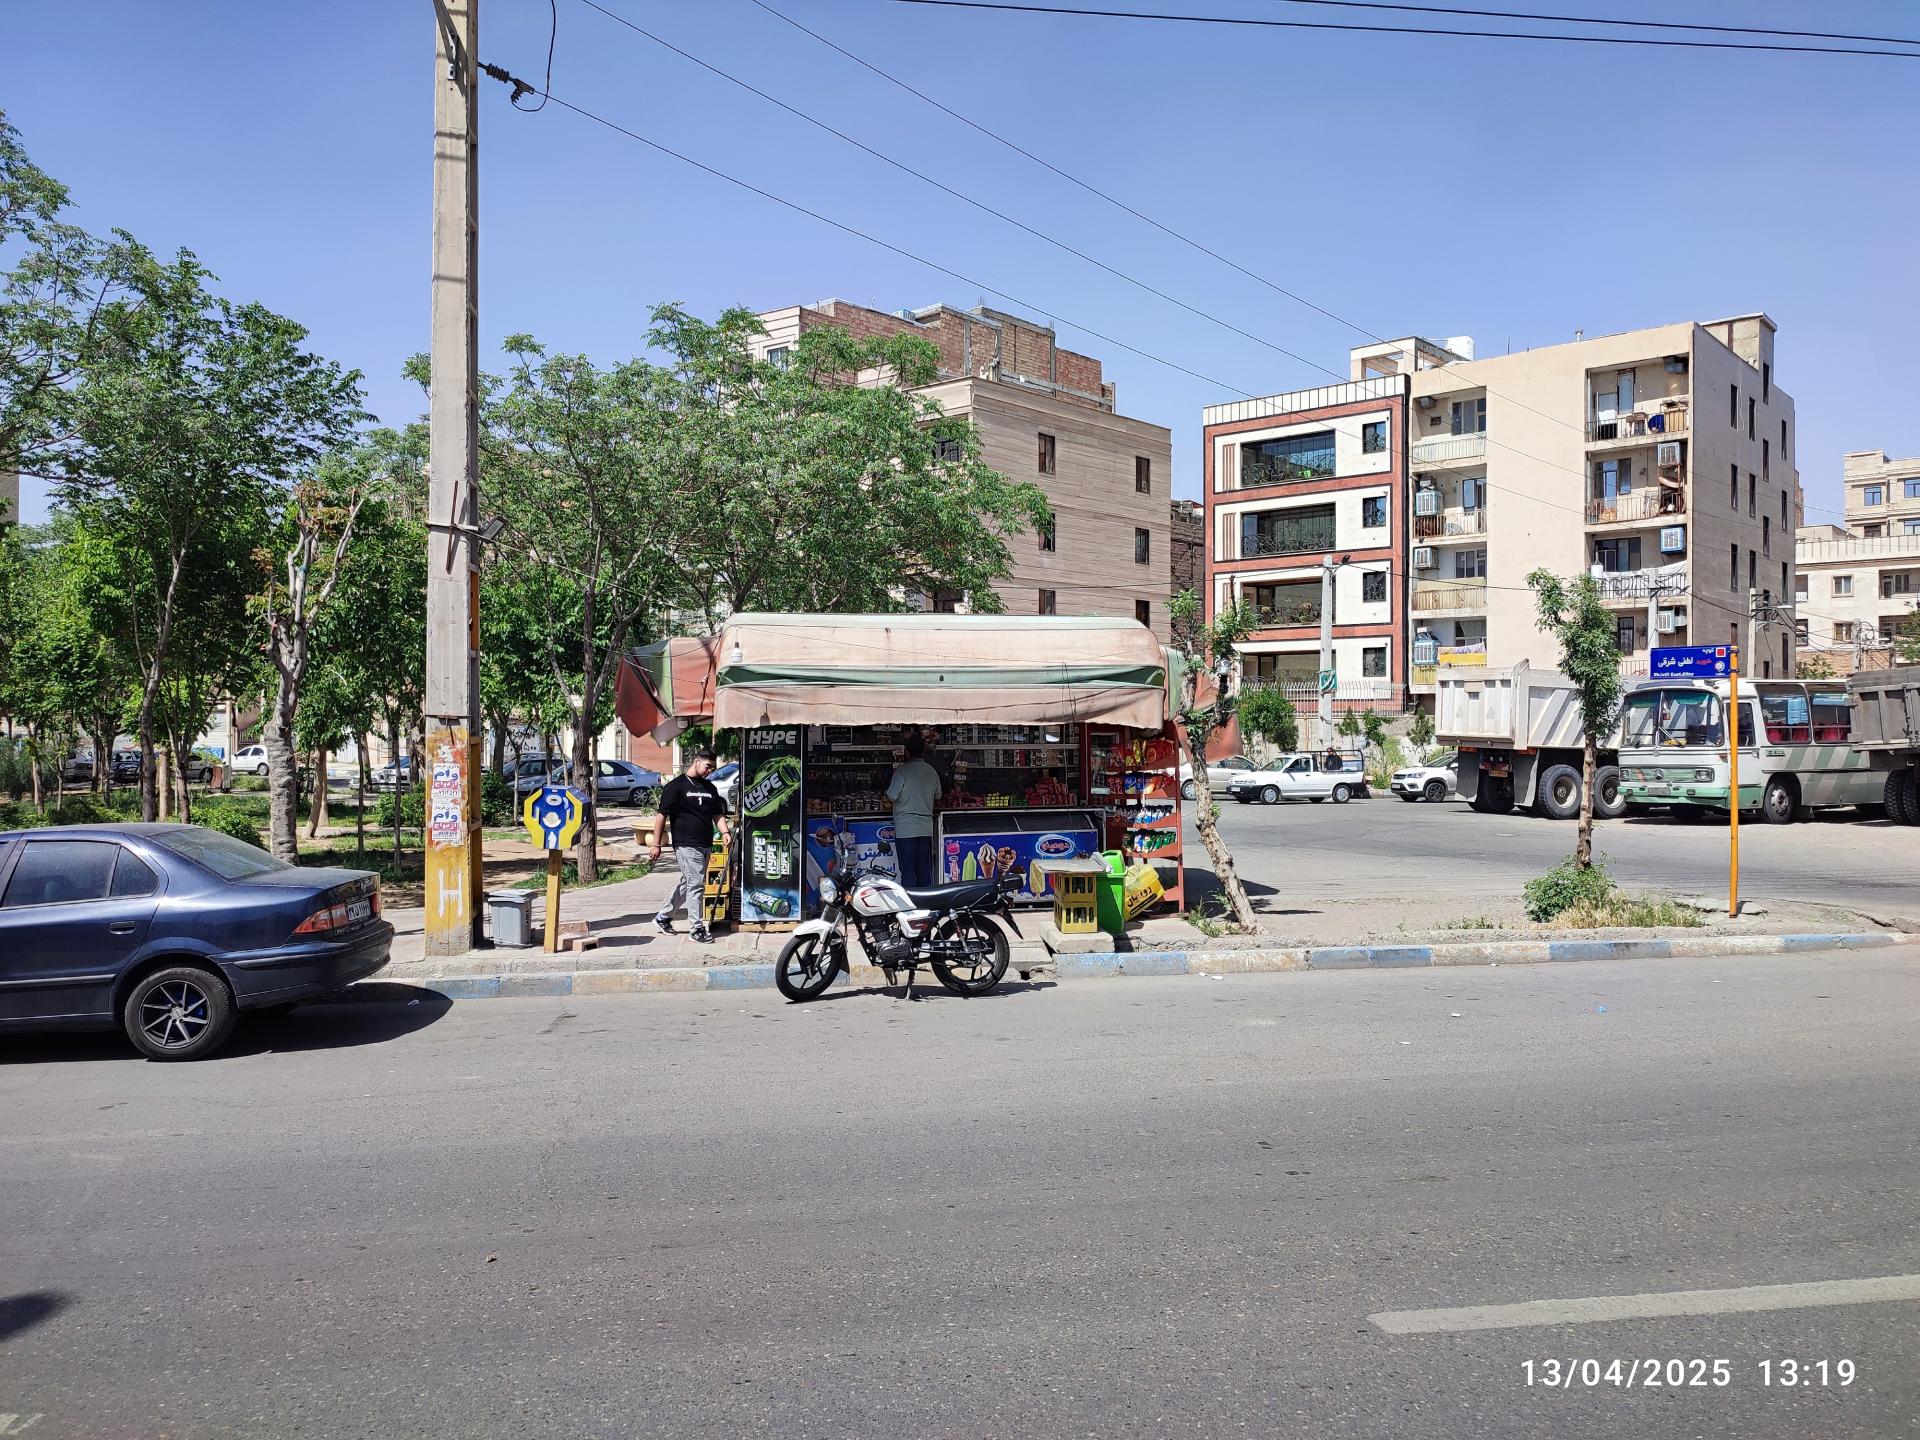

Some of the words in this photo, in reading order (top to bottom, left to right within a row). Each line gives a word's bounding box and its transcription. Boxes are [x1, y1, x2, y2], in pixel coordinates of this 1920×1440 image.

[1658, 657, 1676, 667] شرقی
[1678, 657, 1694, 667] لطفی
[749, 731, 797, 745] HYPE
[434, 769, 459, 781] وام
[744, 772, 783, 809] HYPE
[433, 811, 458, 822] وام
[754, 837, 766, 872] HYPE
[768, 844, 777, 875] HYPE
[780, 851, 789, 875] HYPE
